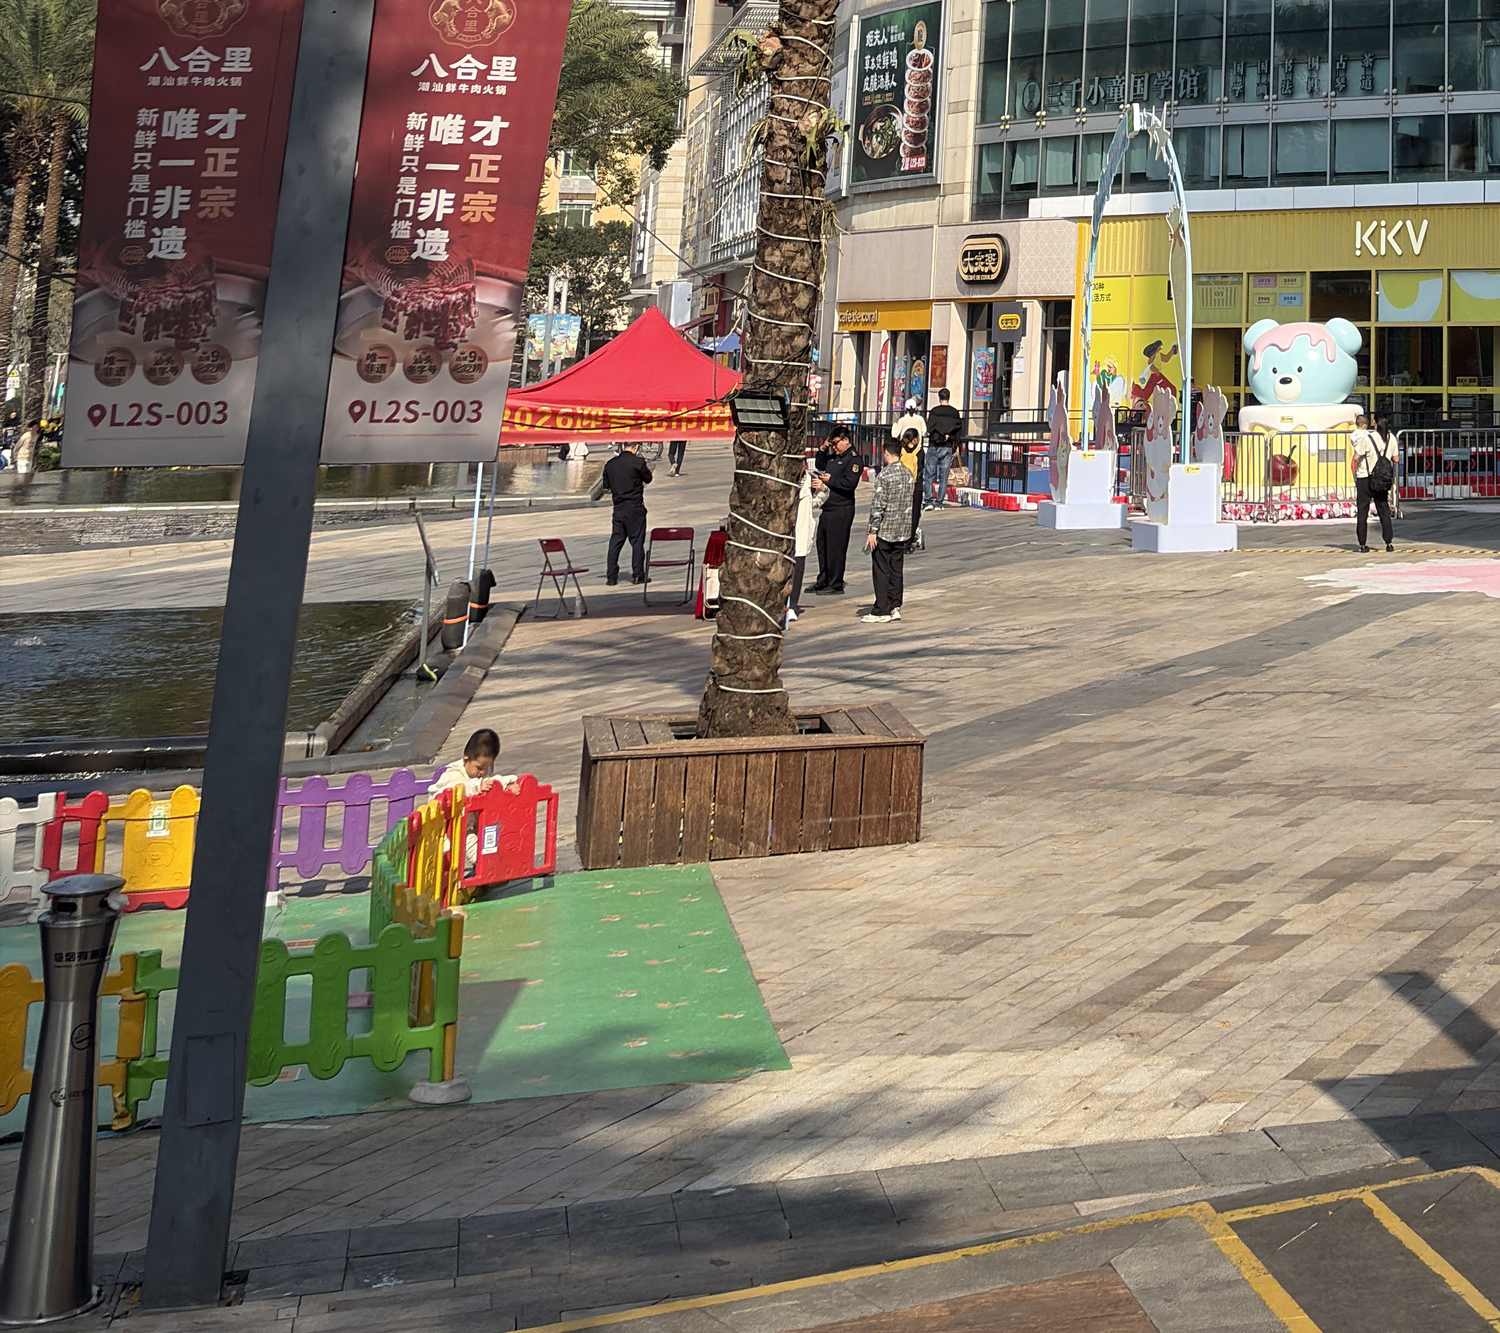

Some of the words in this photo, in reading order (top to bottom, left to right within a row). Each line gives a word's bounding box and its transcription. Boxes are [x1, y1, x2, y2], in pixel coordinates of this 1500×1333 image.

[139, 45, 253, 73] 八合里
[411, 53, 517, 81] 八合里
[147, 76, 243, 87] 潮汕鲜牛肉火锅
[418, 82, 507, 95] 潮汕鲜牛肉火锅
[123, 107, 159, 239] 新鲜只是门槛
[198, 108, 246, 219] 才正宗
[390, 112, 428, 239] 新鲜只是门槛
[460, 115, 510, 222] 才正宗
[147, 108, 200, 260] 唯一非遗
[411, 113, 466, 261] 唯一非遗
[1092, 293, 1111, 302] 活方式
[110, 401, 228, 427] L2S-003
[369, 400, 483, 423] L2S-003
